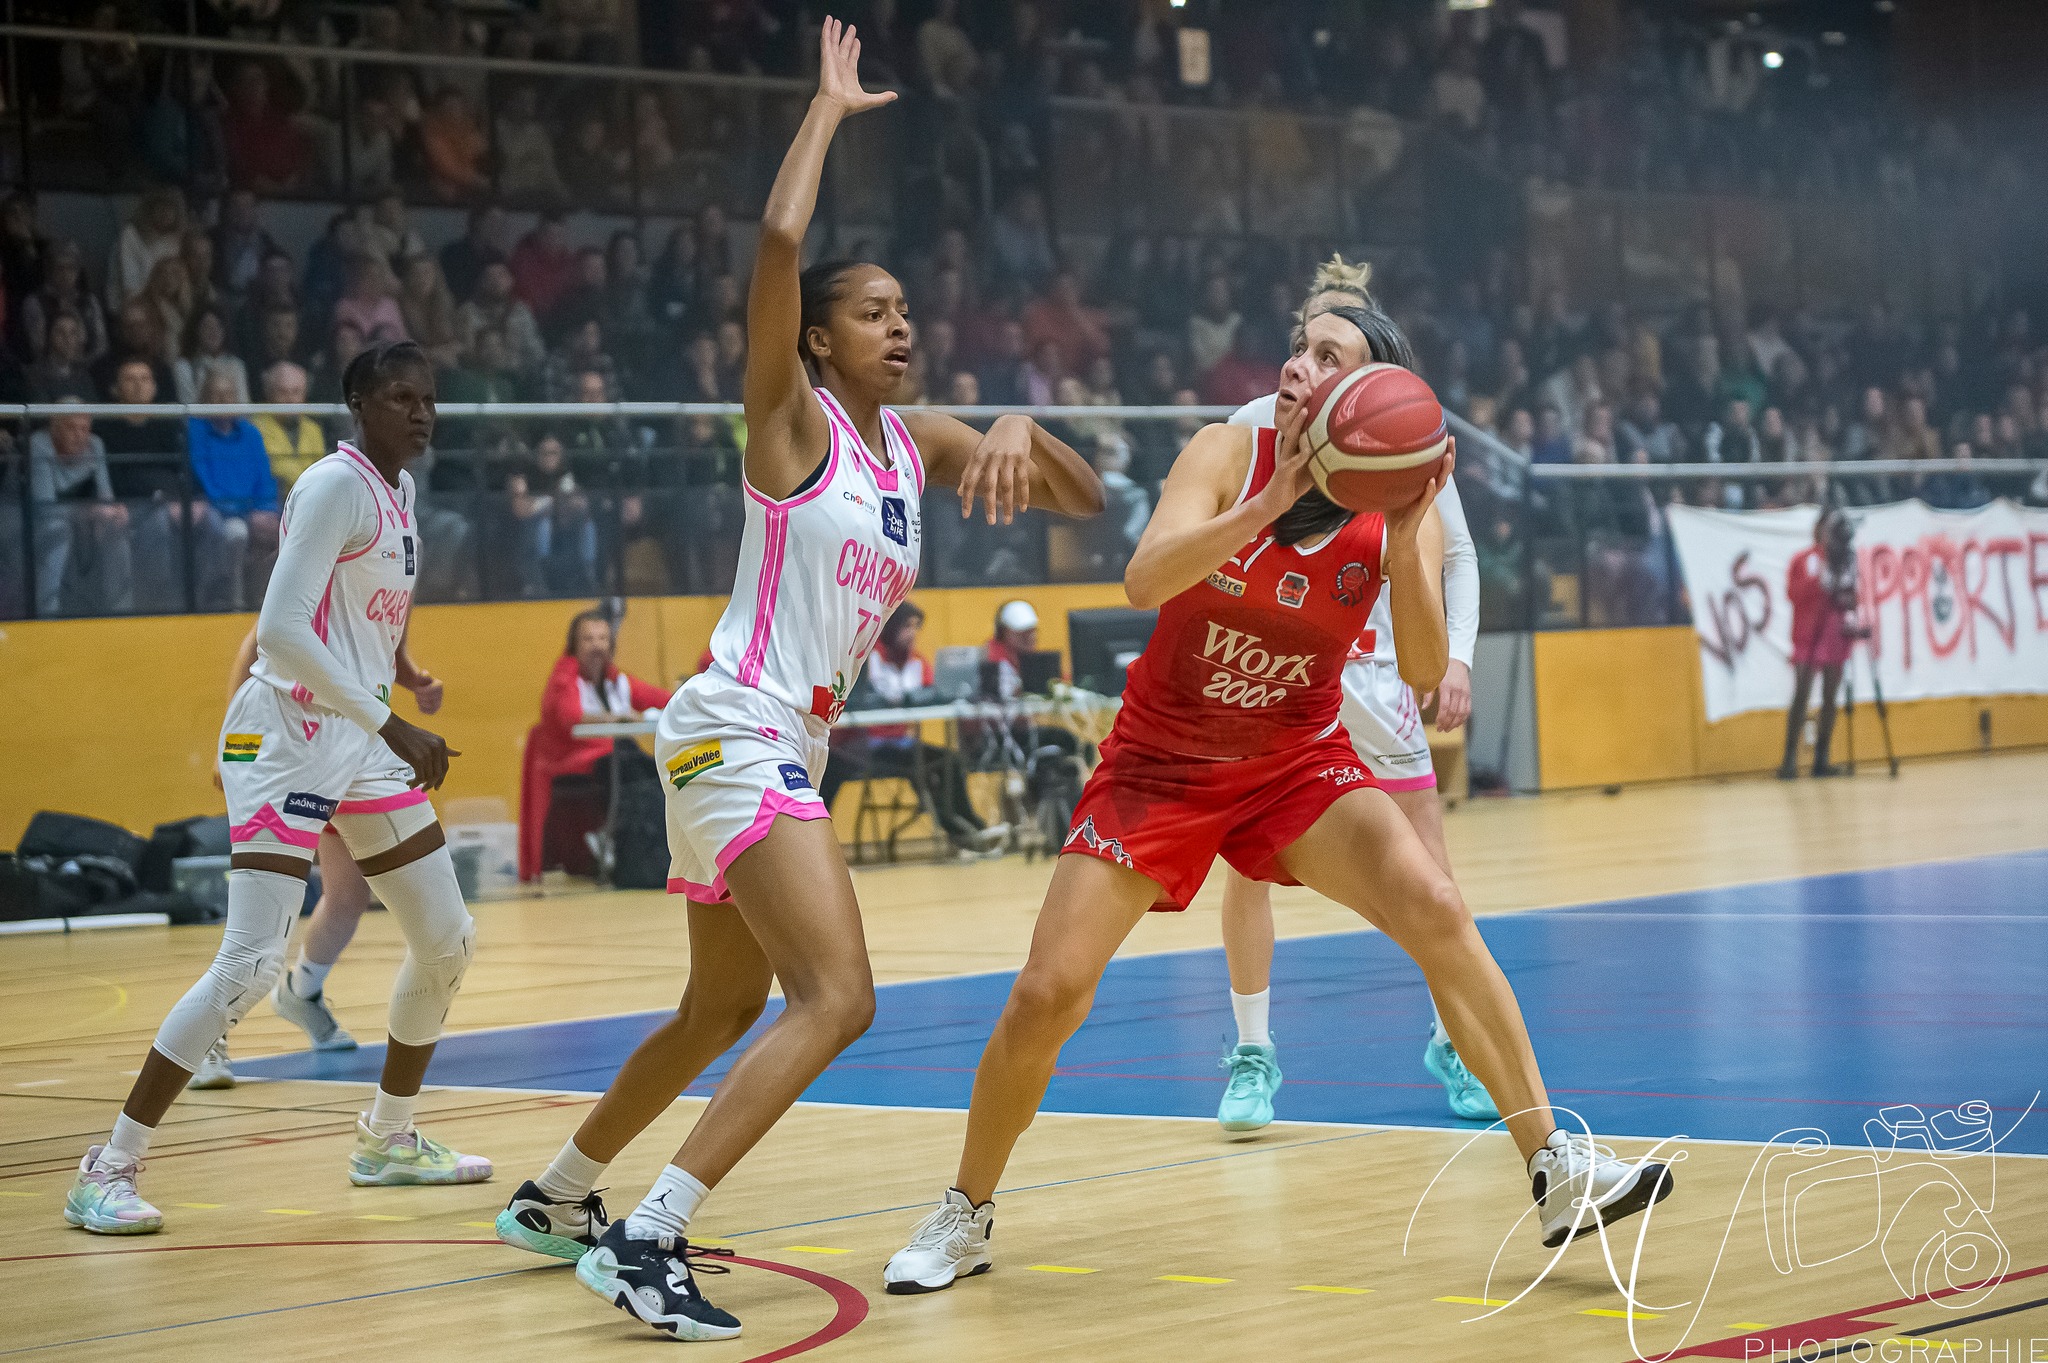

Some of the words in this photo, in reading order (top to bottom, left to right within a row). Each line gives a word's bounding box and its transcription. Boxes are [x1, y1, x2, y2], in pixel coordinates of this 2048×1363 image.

[843, 491, 876, 514] Charnay
[848, 607, 881, 660] 77
[1203, 620, 1318, 688] Work
[288, 797, 317, 811] SAÔNE
